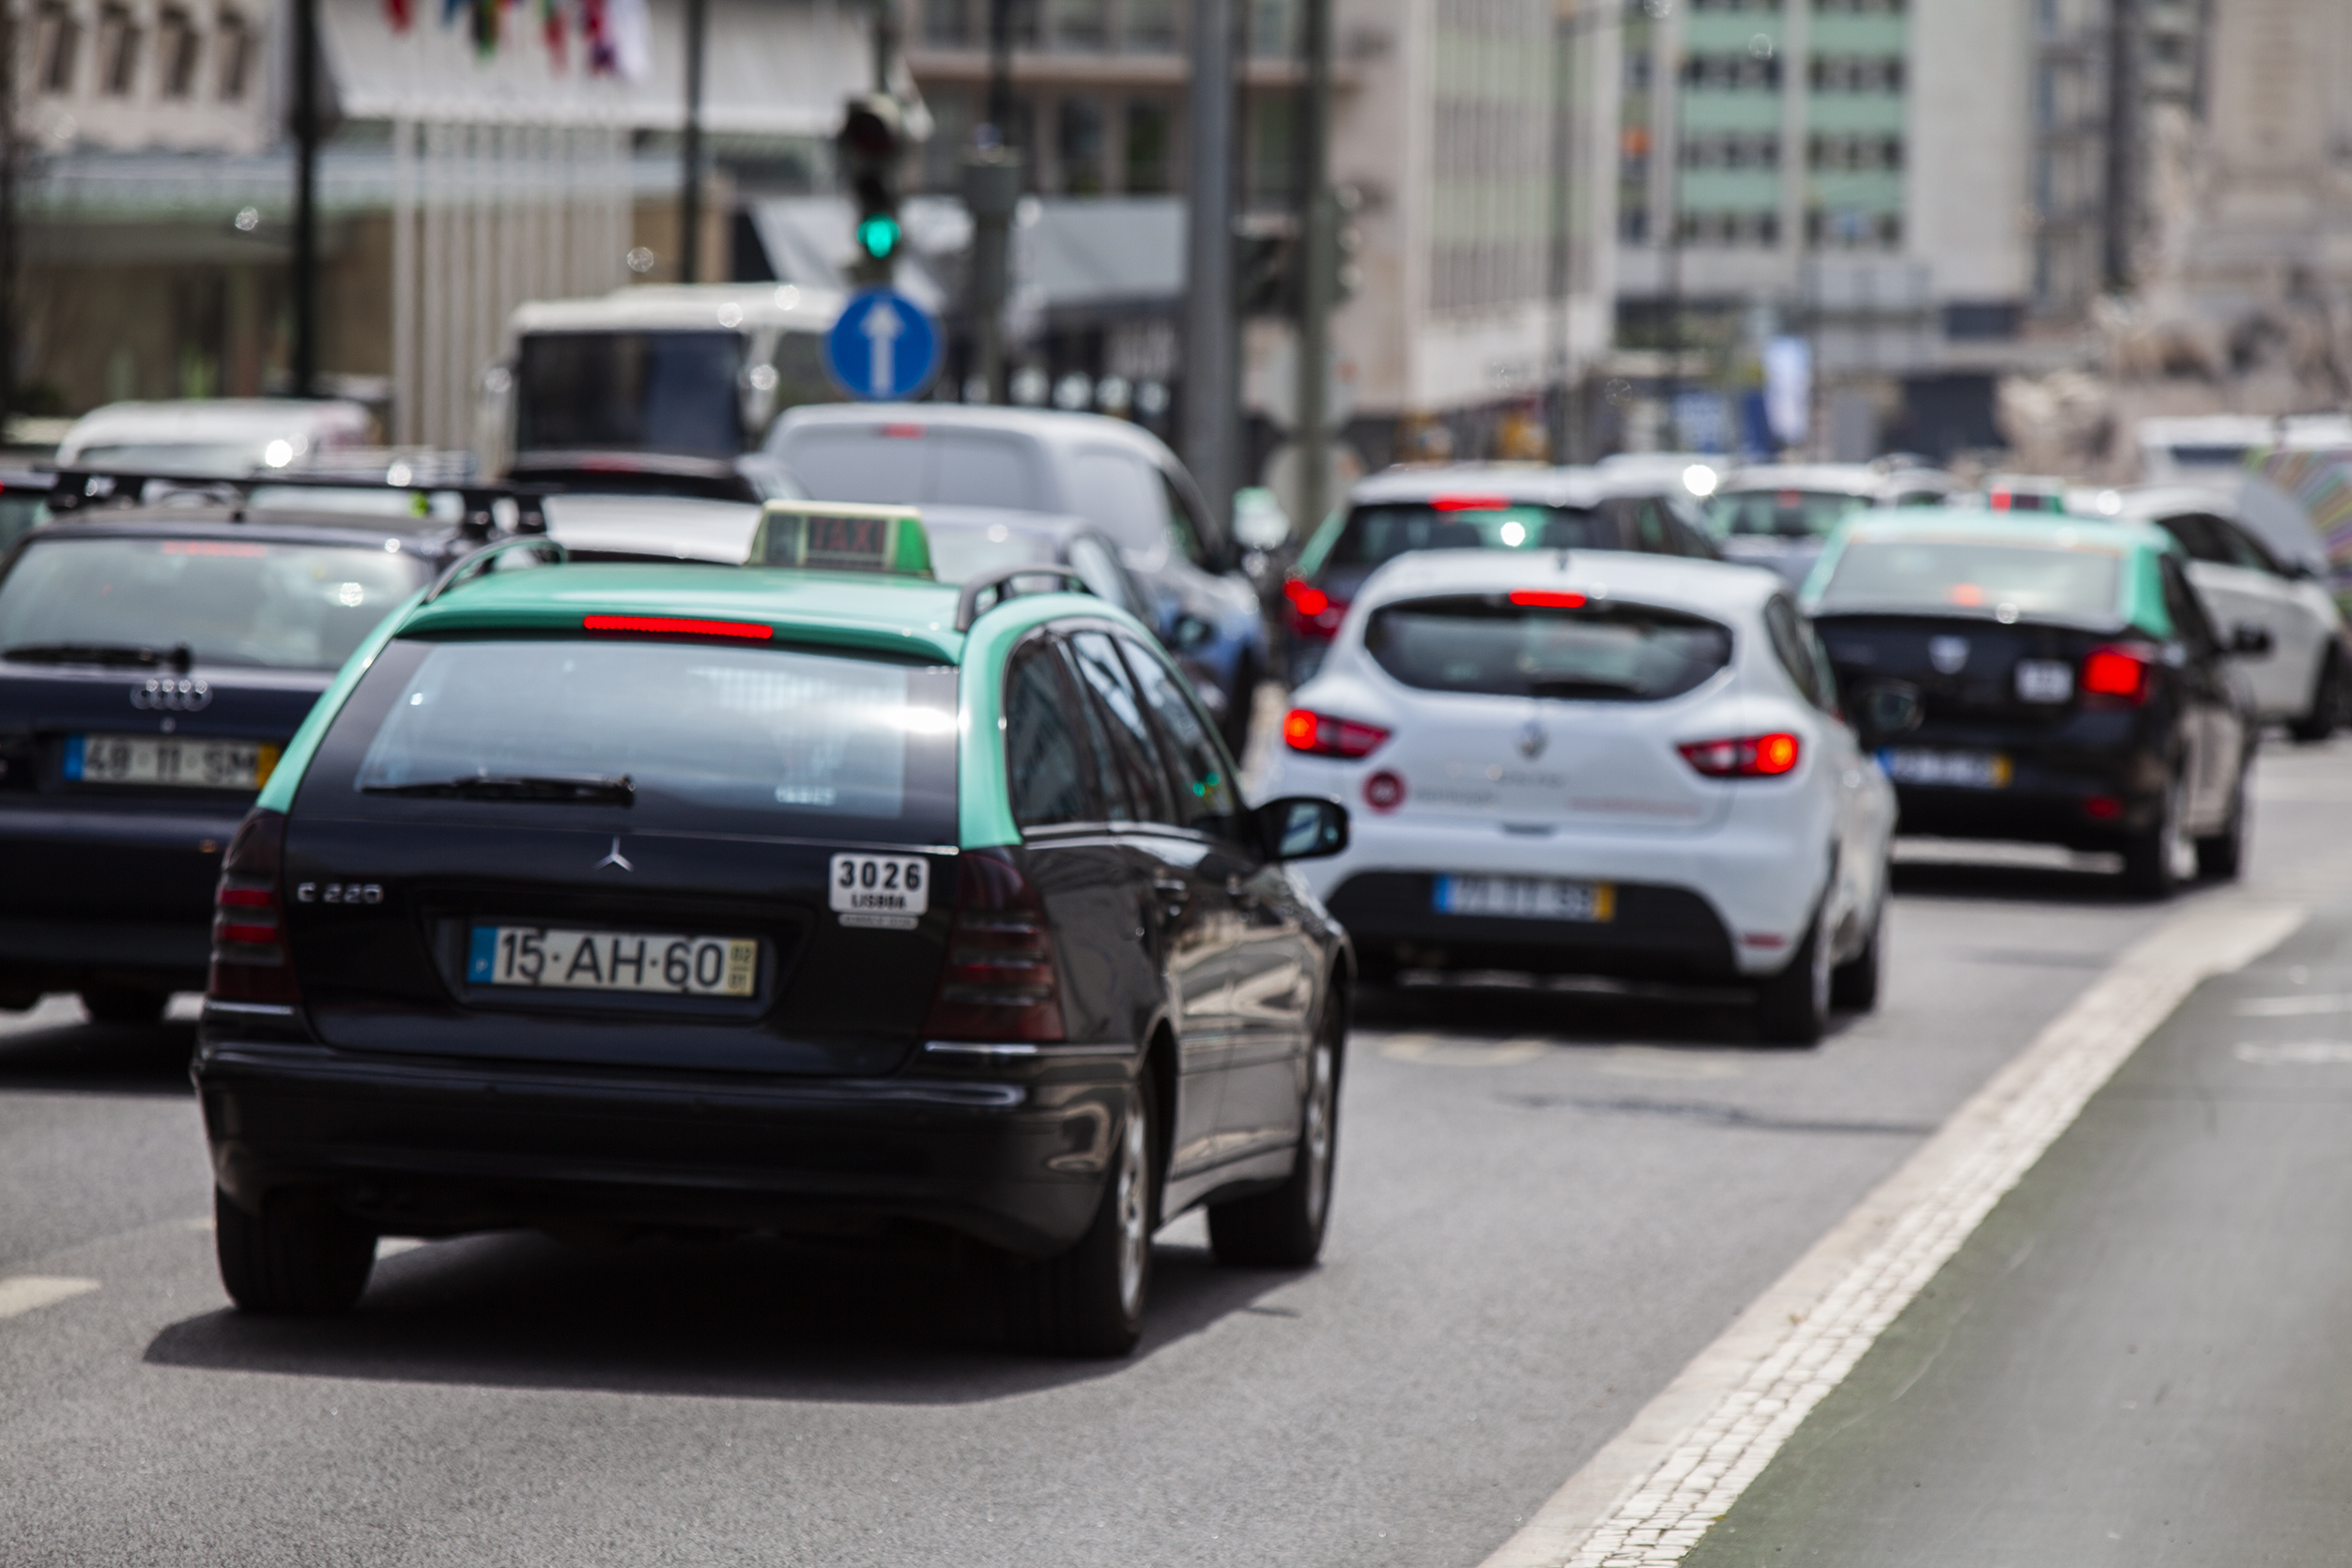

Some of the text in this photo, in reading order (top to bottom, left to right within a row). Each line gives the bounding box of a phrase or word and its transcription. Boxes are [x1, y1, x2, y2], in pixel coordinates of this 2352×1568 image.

[809, 515, 886, 553] TAXI
[838, 860, 922, 892] 3026
[298, 882, 383, 903] C 220
